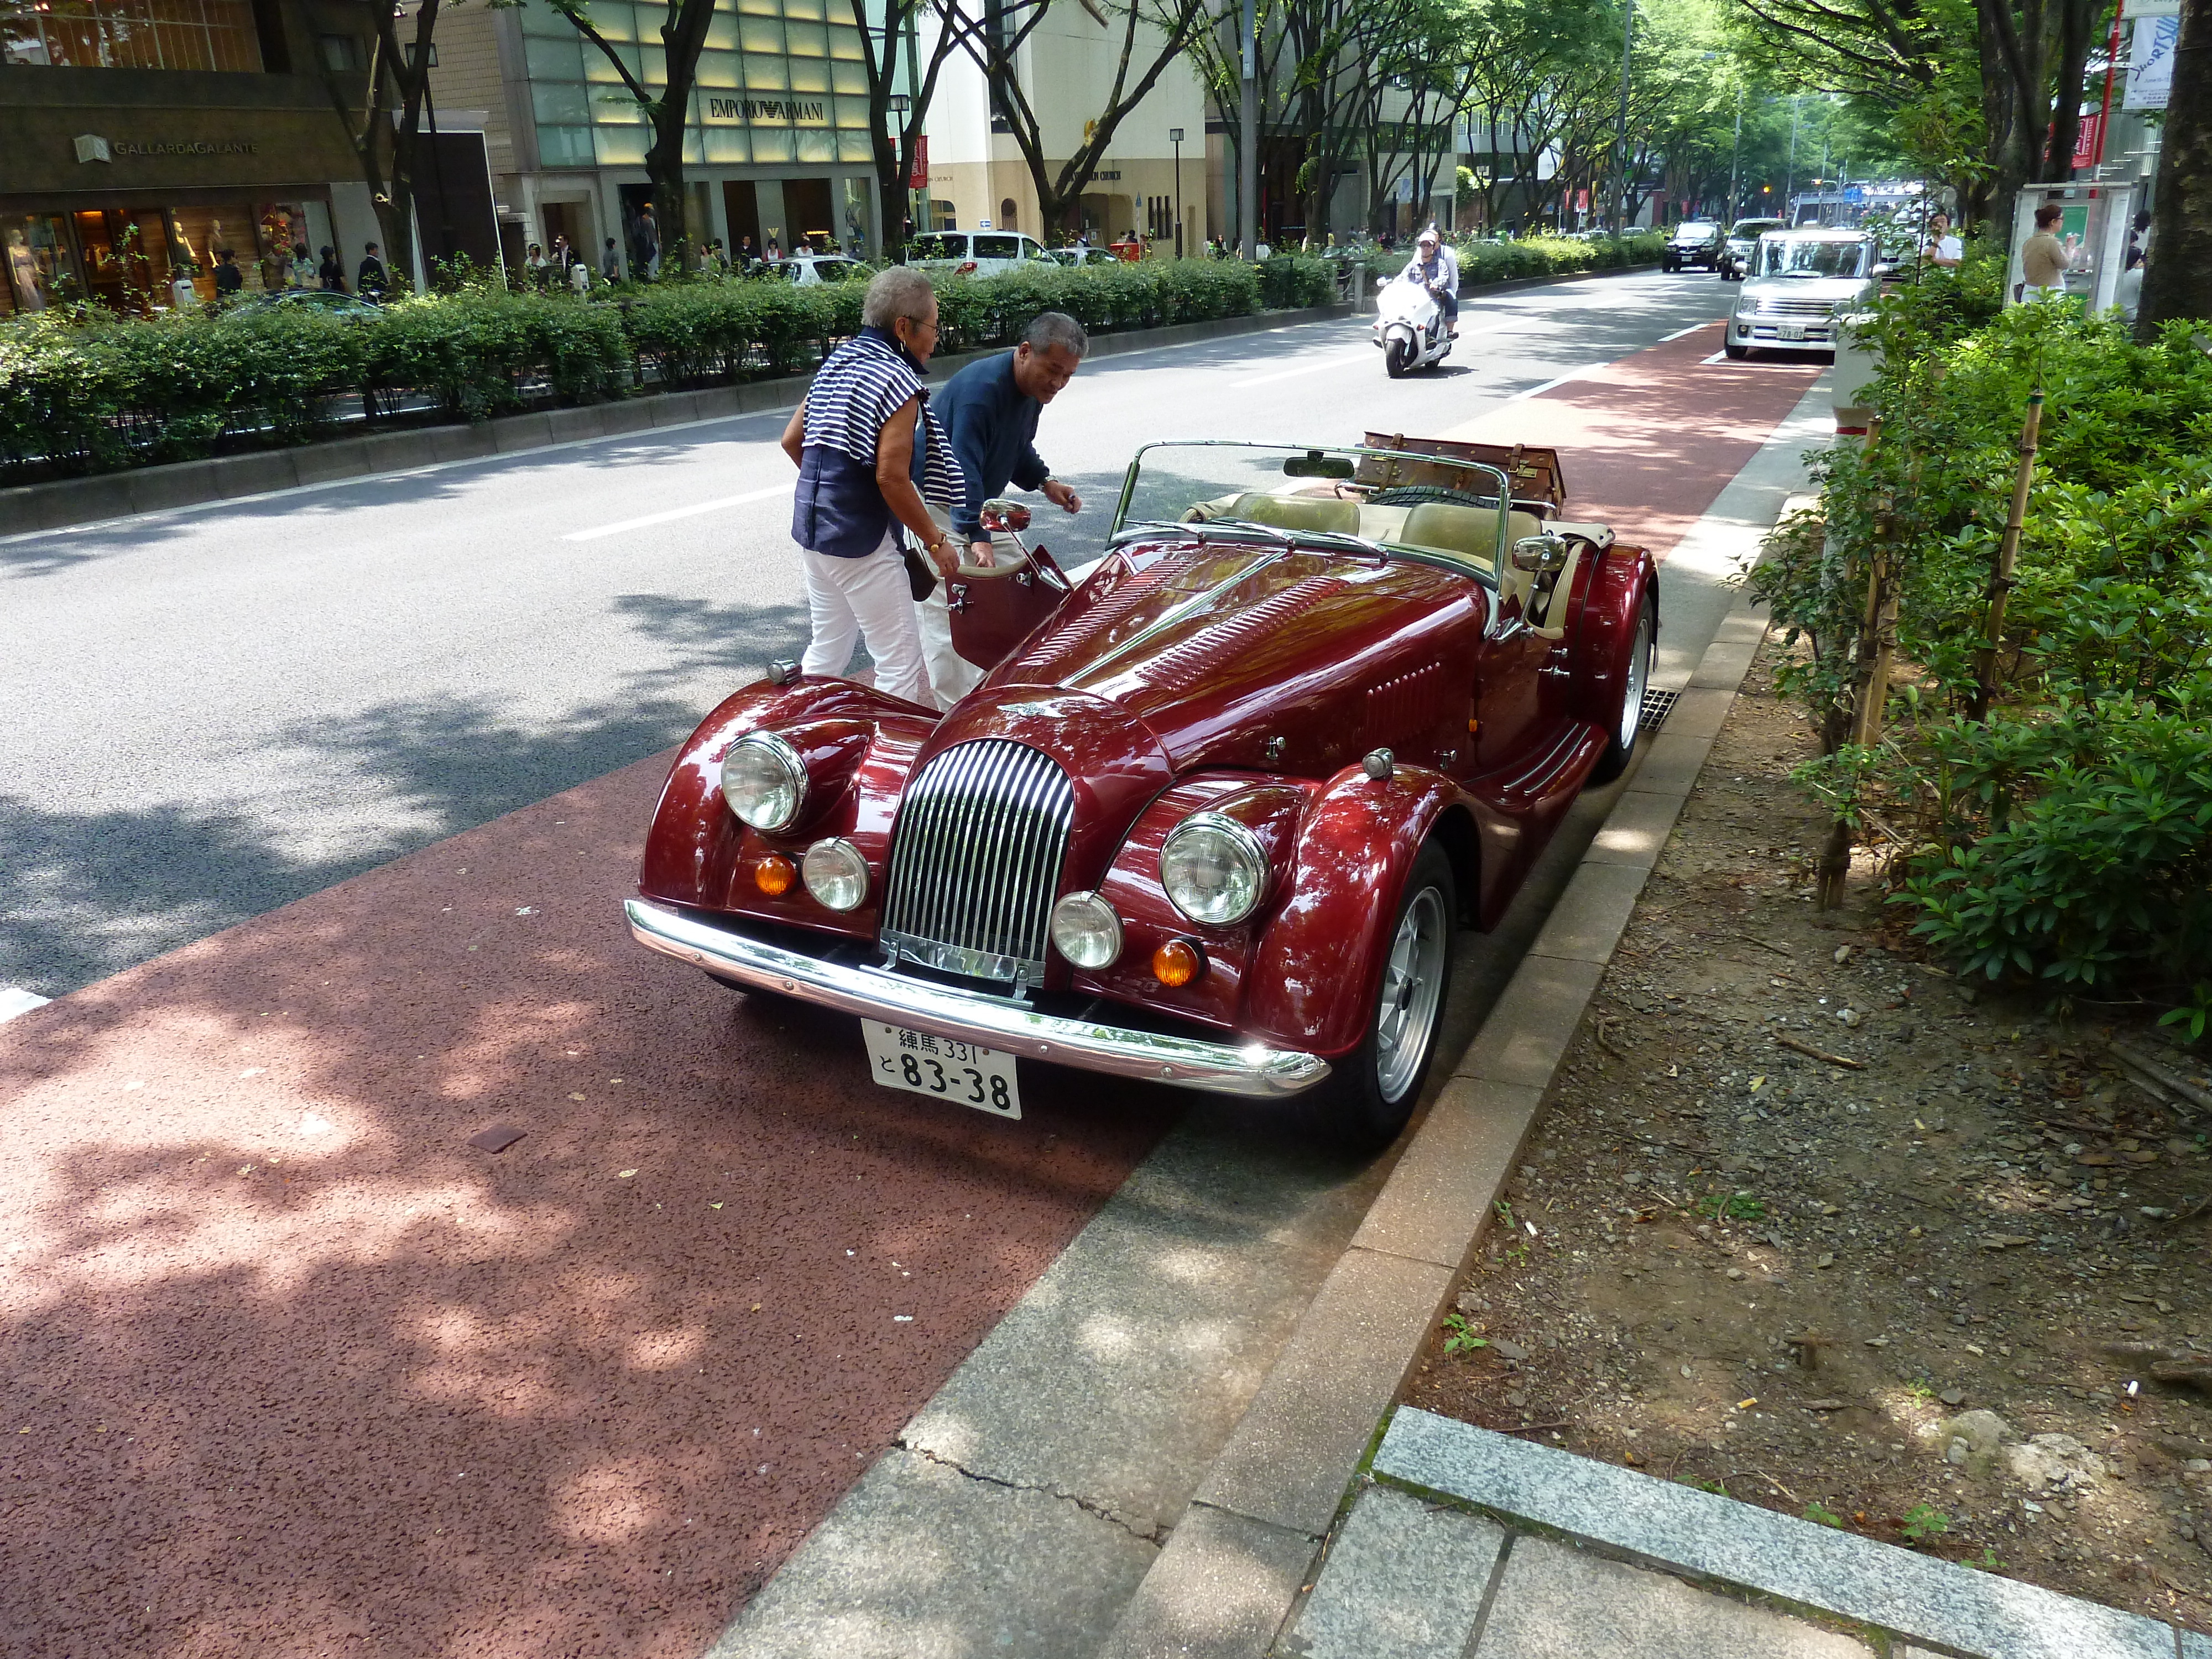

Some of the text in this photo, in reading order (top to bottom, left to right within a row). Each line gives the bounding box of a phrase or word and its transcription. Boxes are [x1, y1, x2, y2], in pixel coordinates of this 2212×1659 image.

[710, 98, 823, 120] EMPORIO ARMANI
[1100, 170, 1121, 181] CHURCH
[898, 1029, 977, 1065] 練馬 331
[879, 1053, 1011, 1110] と 83-38
